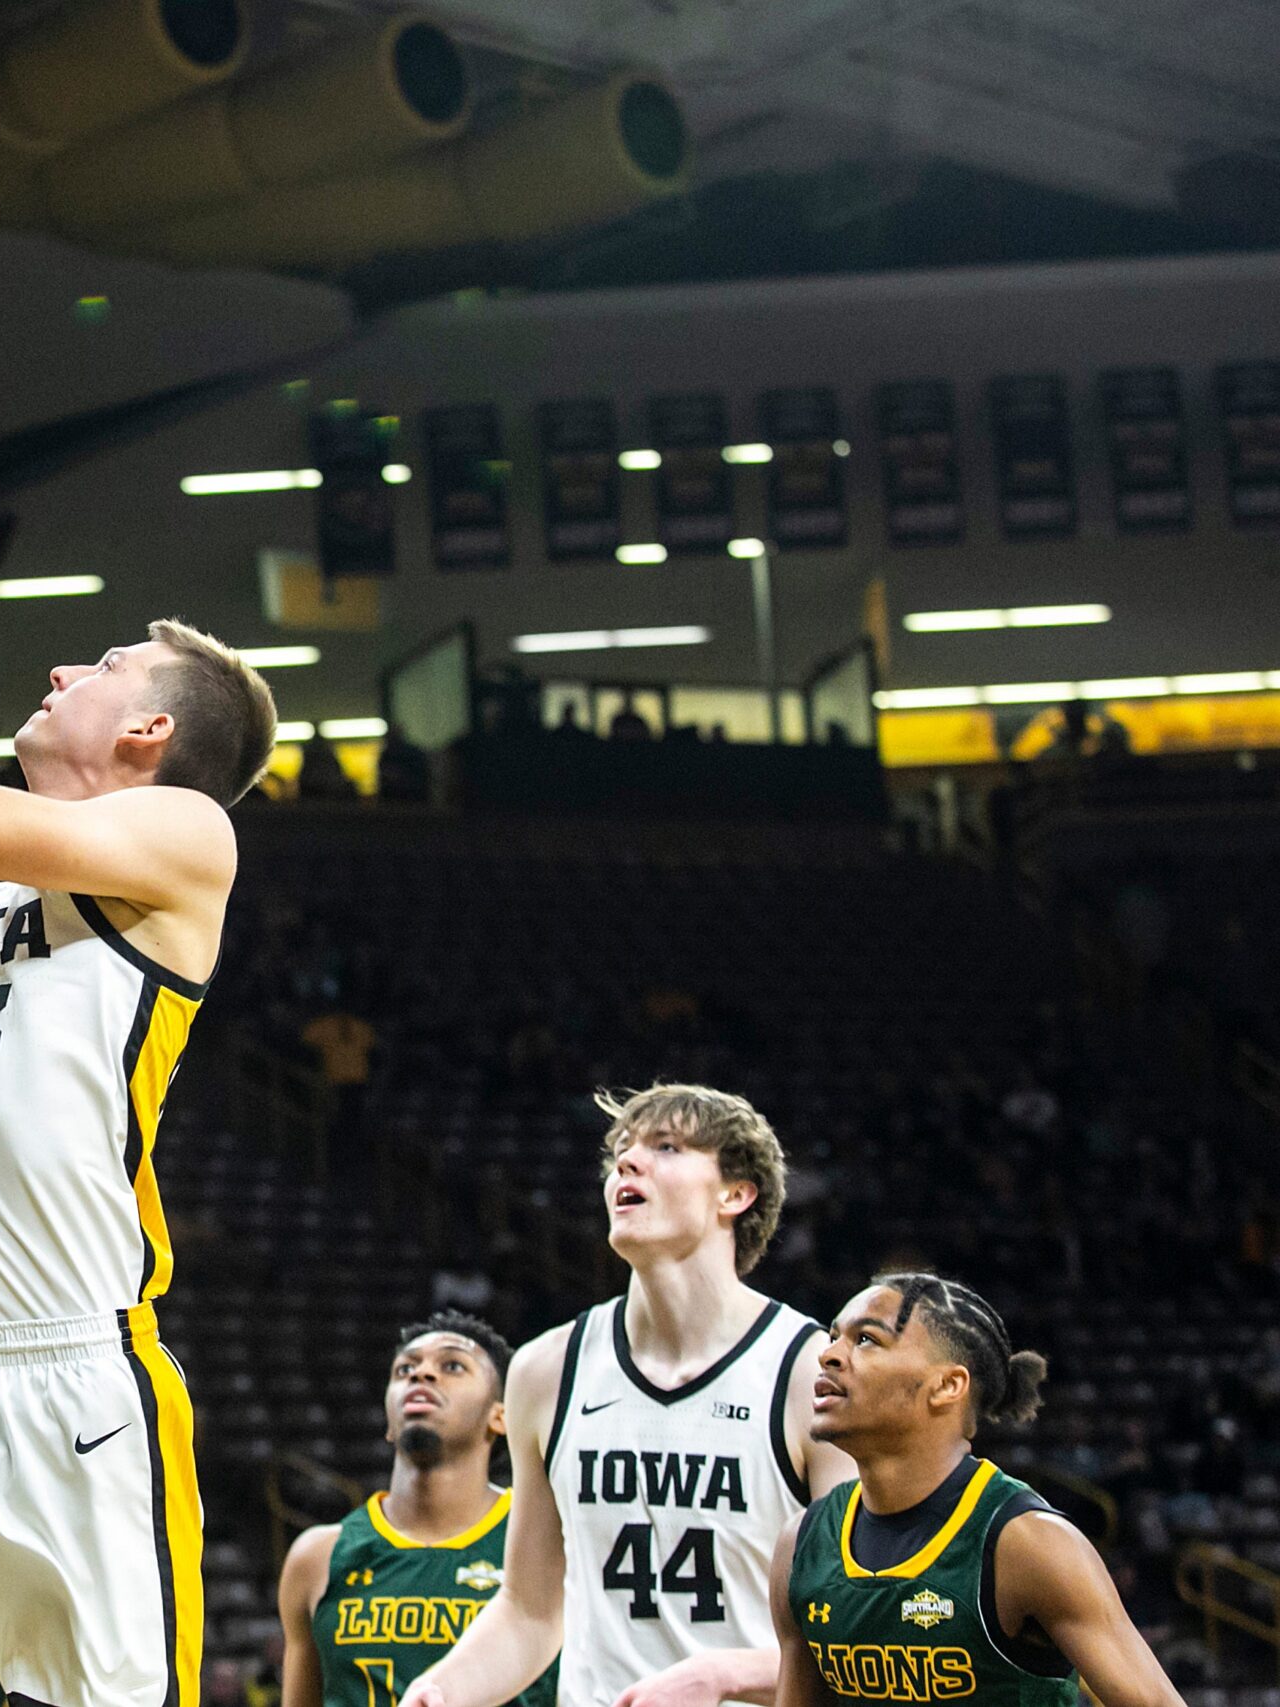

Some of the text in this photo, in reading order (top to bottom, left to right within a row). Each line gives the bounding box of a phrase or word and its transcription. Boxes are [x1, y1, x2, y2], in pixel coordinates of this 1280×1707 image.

[578, 1450, 747, 1513] IOWA
[603, 1523, 725, 1623] 44
[334, 1597, 491, 1646] LION
[808, 1640, 977, 1702] LIONS
